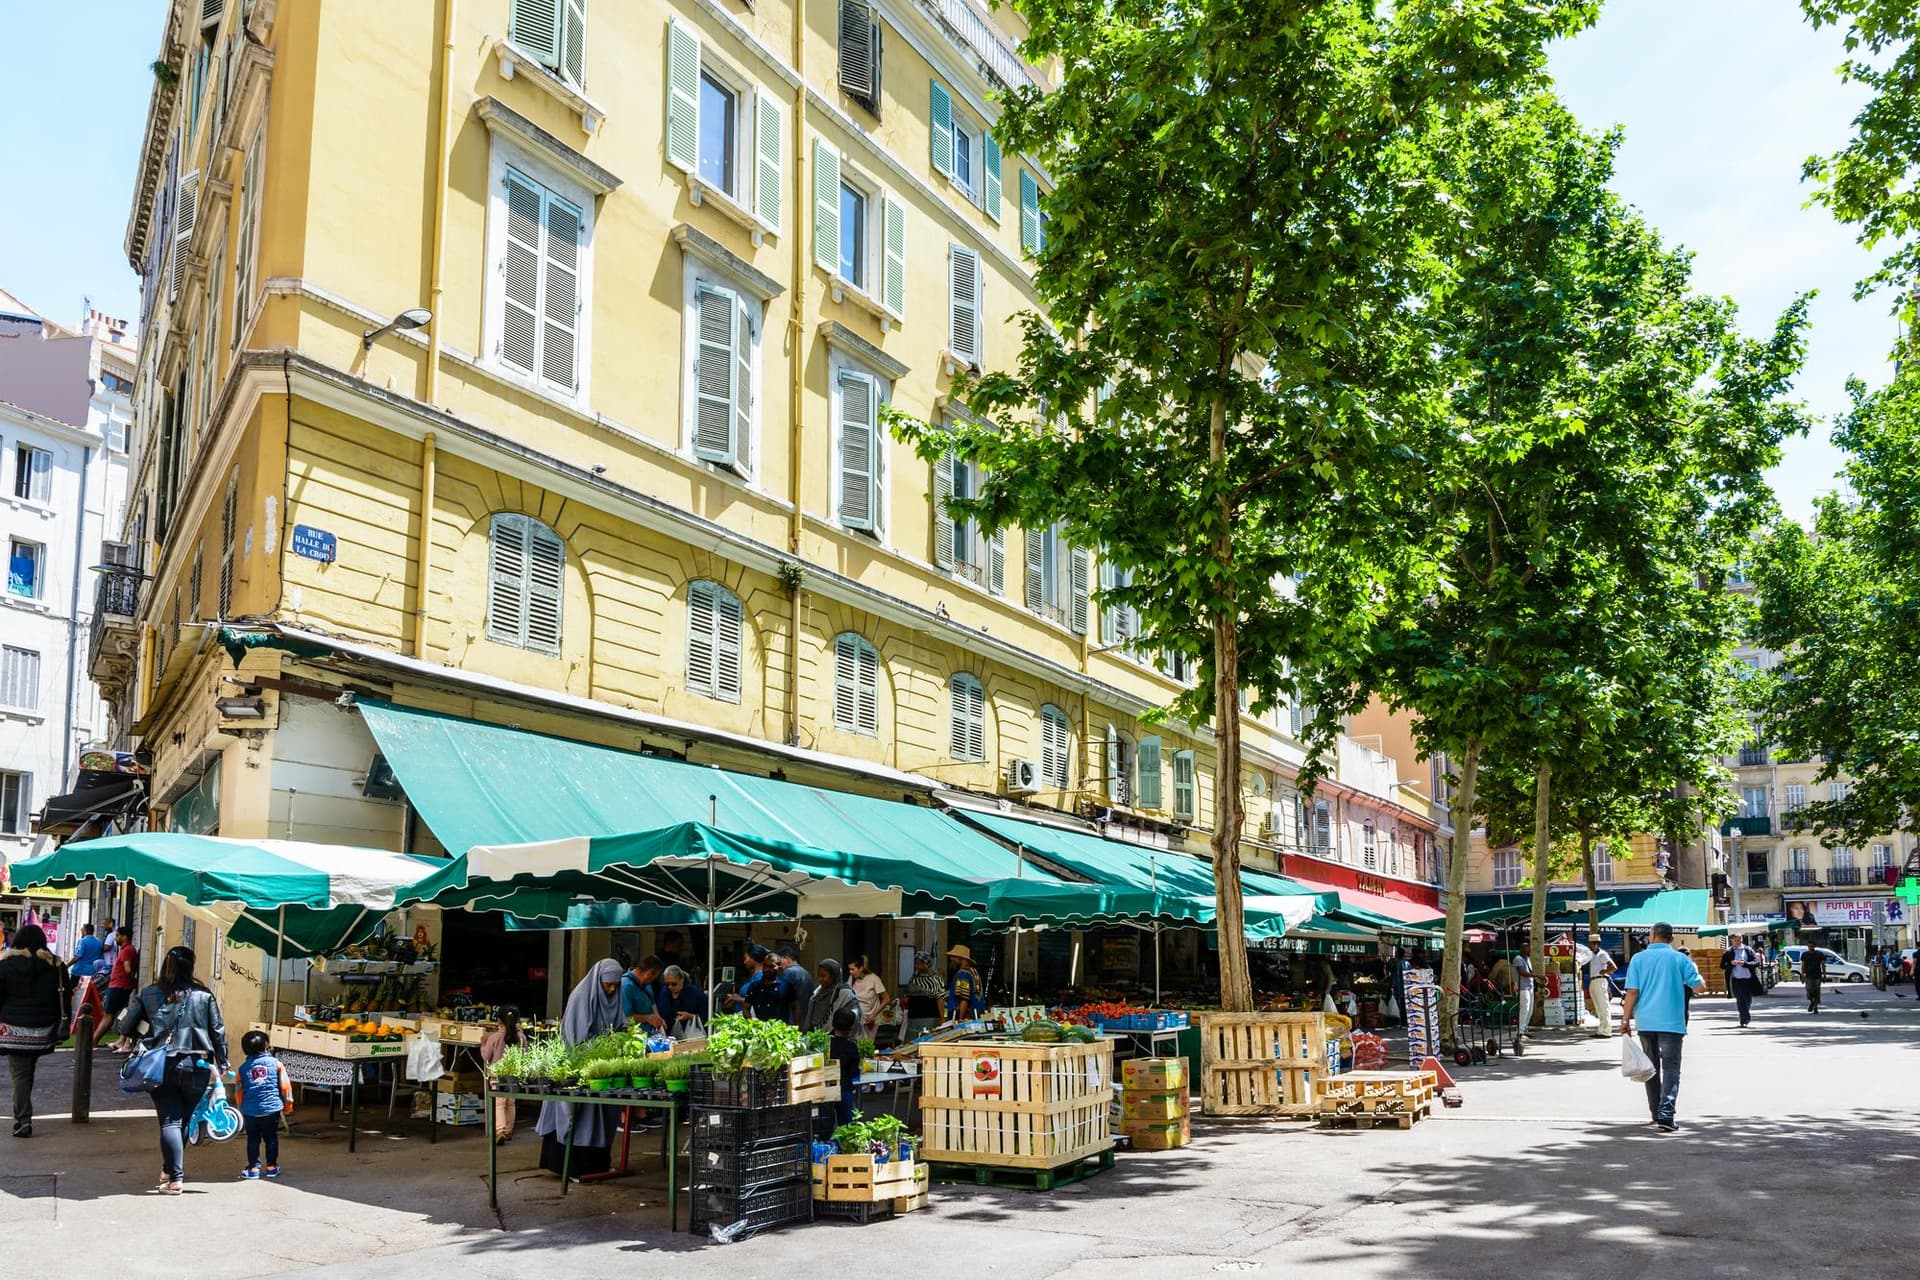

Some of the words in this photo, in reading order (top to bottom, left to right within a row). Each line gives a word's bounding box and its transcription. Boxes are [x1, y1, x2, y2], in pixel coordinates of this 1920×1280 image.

[307, 529, 324, 540] RUE
[295, 534, 320, 549] HALLE
[296, 545, 306, 555] LA
[1826, 902, 1854, 911] FUTUR
[1857, 901, 1872, 909] LIN
[1849, 909, 1872, 920] AFR
[1263, 938, 1278, 949] DES
[371, 1044, 401, 1055] Numen
